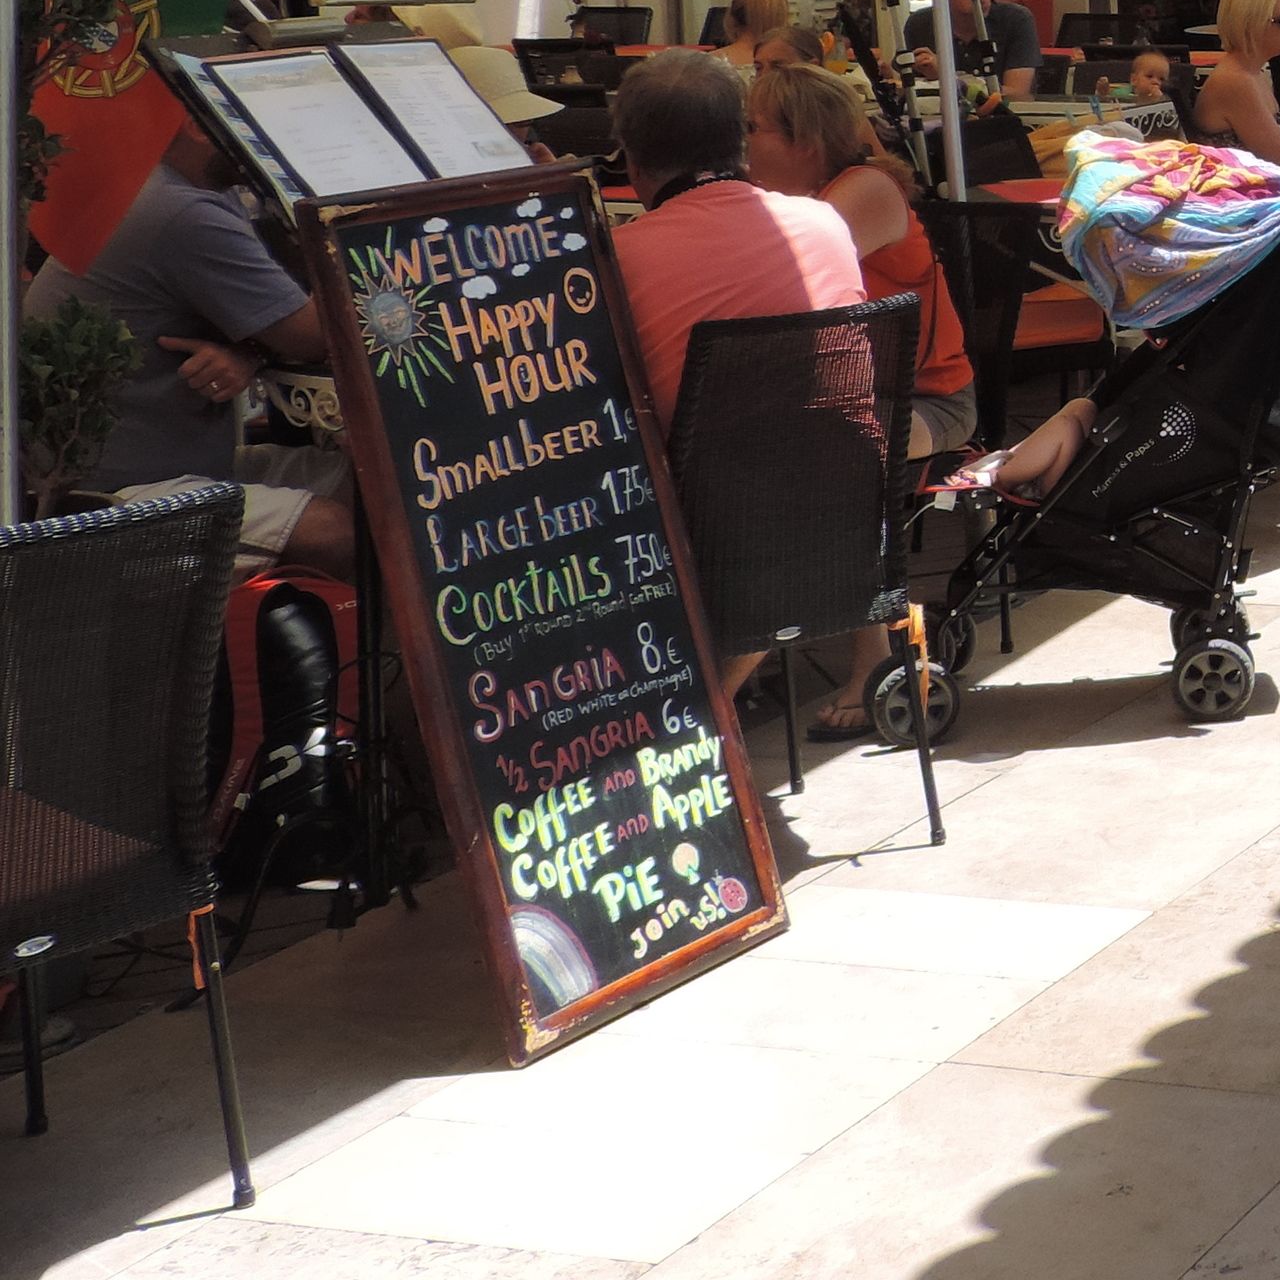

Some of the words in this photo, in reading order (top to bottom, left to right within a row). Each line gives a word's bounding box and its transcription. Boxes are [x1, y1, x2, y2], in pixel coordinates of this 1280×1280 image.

[377, 216, 560, 287] WELCOME
[438, 292, 555, 363] HAPPY
[473, 339, 597, 416] HOUR
[1125, 439, 1155, 462] Papas
[426, 508, 534, 574] LARGE
[436, 553, 612, 646] COCKTAILS
[578, 693, 617, 715] WHITE
[617, 813, 649, 843] AND
